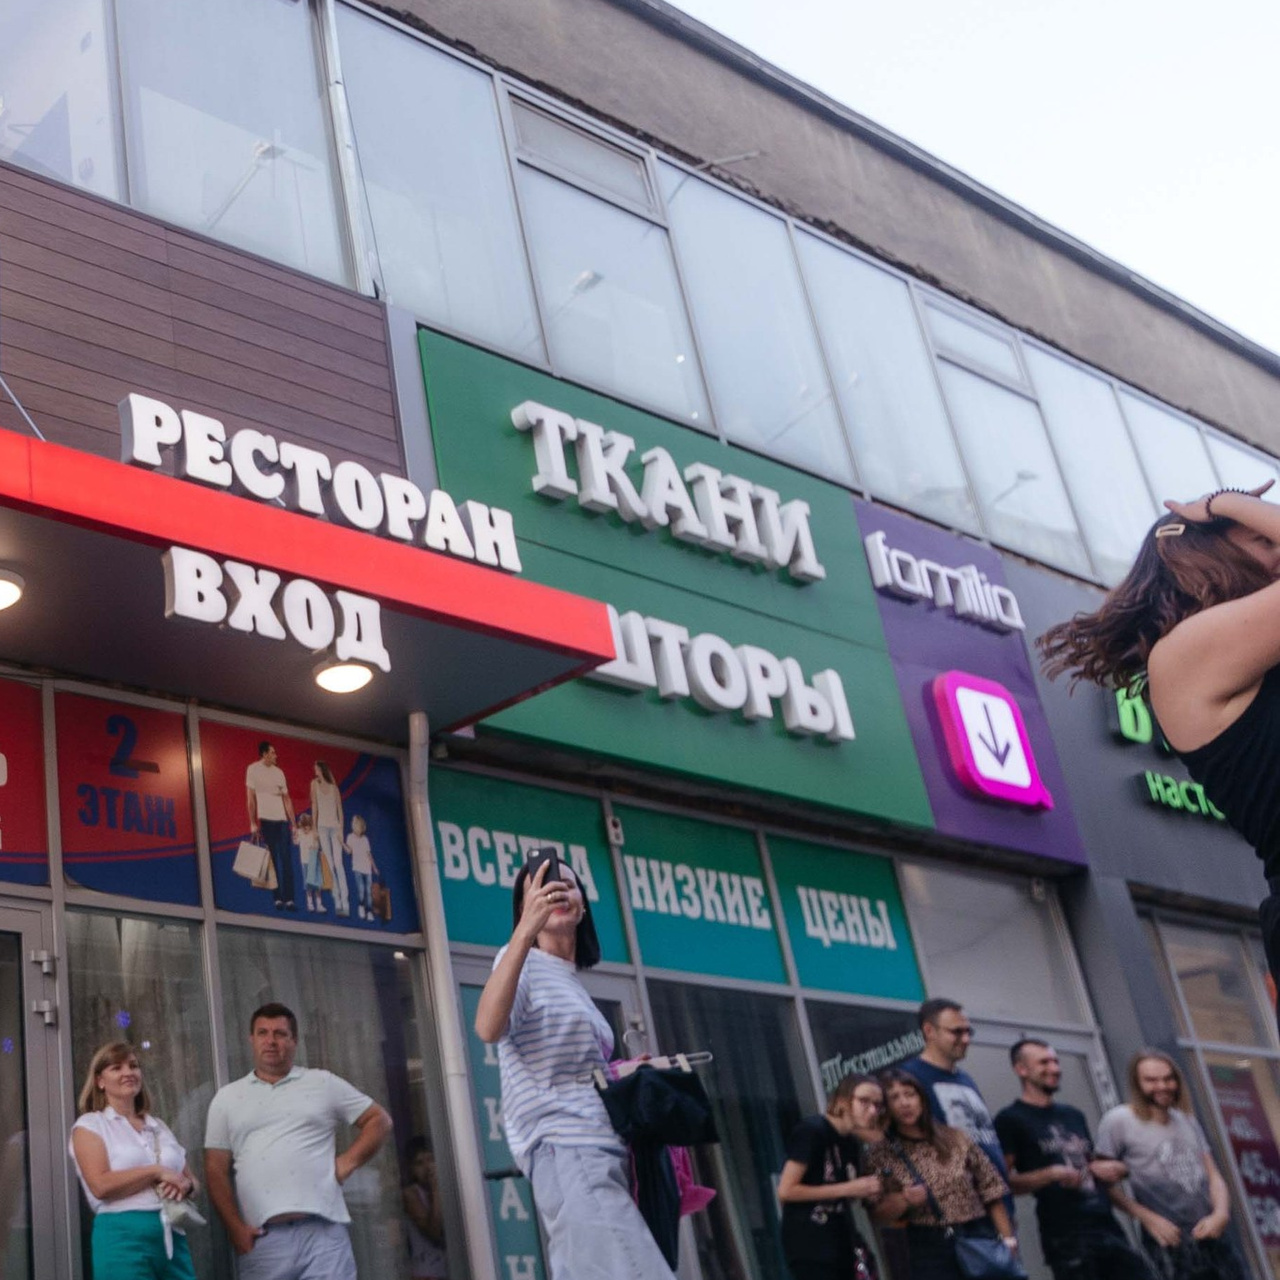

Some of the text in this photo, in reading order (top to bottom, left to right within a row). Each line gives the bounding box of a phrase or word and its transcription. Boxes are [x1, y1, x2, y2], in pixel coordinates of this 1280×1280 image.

[121, 392, 522, 573] РЕСТОРАН
[511, 400, 826, 583] ТКАНИ
[163, 546, 391, 673] ВХОД
[865, 530, 1026, 630] familia
[106, 714, 138, 778] 2
[77, 783, 177, 840] ЭТАЖ
[624, 856, 773, 931] НИЗКИЕ
[796, 886, 898, 951] ЦЕНЫ
